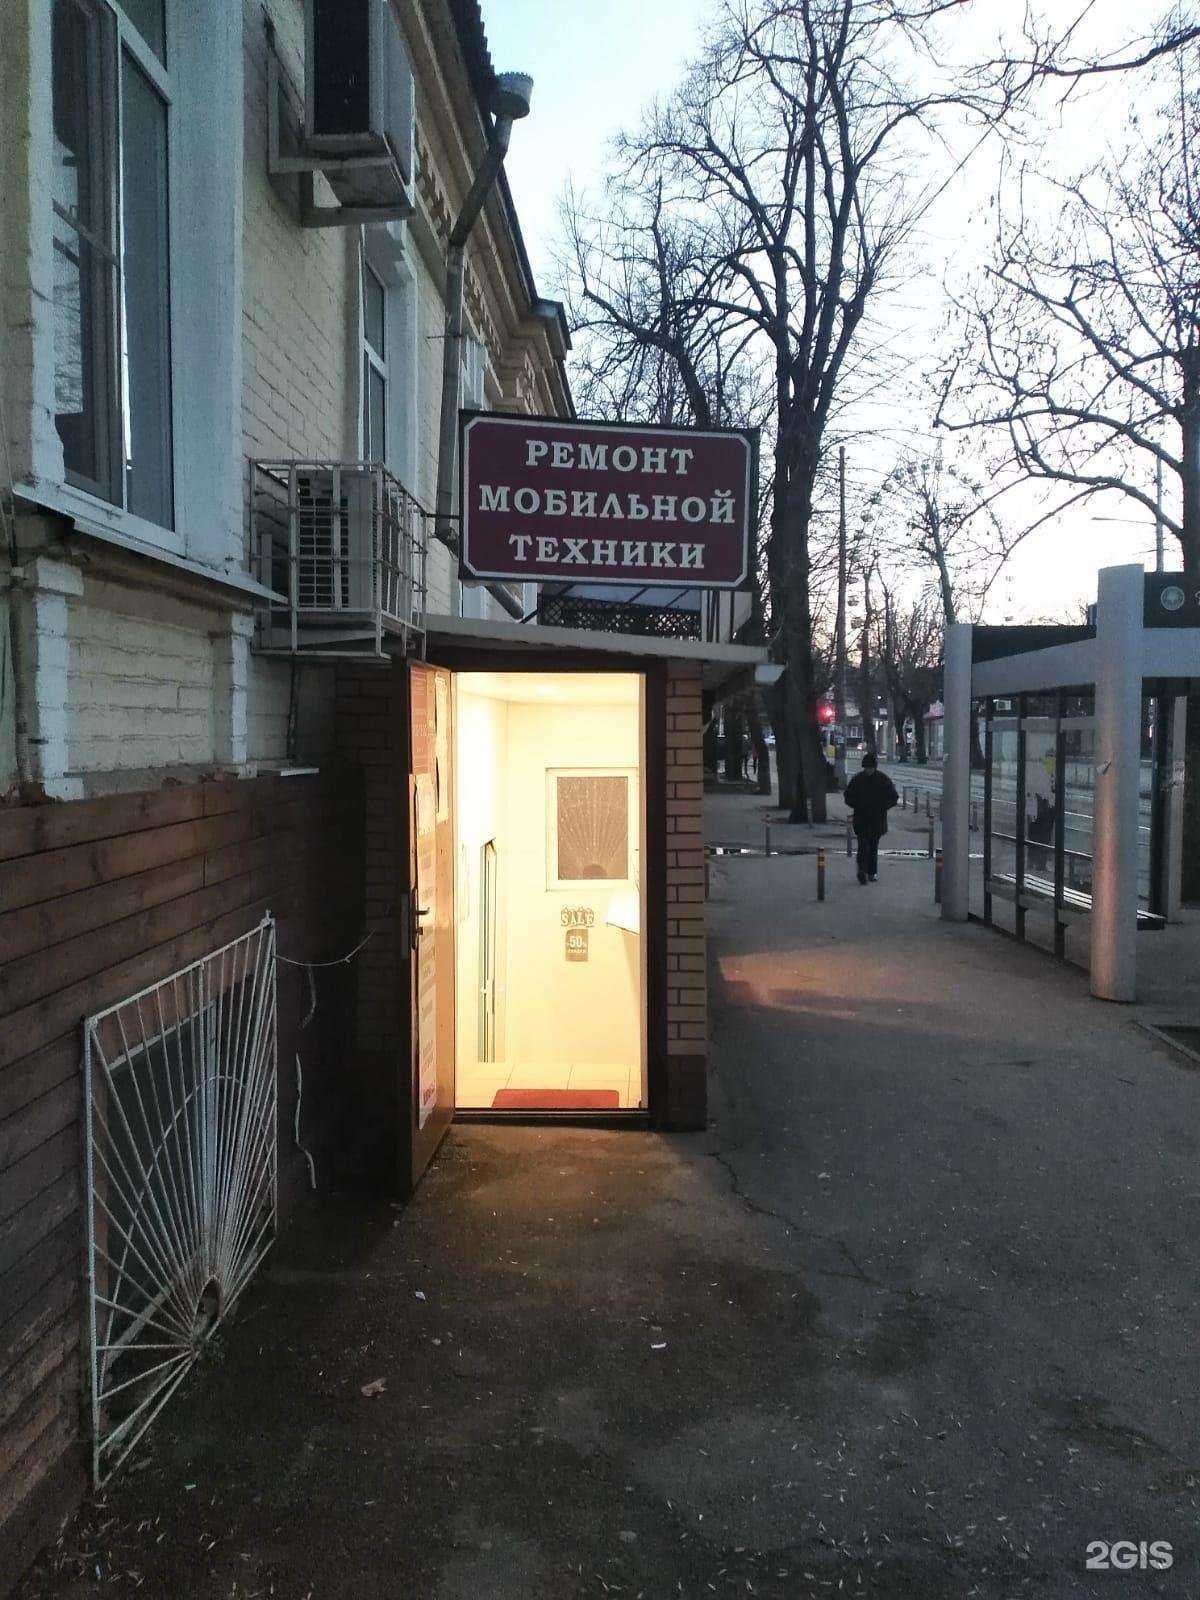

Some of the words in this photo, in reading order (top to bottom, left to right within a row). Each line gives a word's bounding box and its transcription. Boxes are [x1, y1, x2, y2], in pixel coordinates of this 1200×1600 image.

[525, 439, 695, 475] РЕМОНТ
[478, 484, 736, 524] МОБИЛЬНОЙ
[508, 534, 706, 569] ТЕХНИКИ
